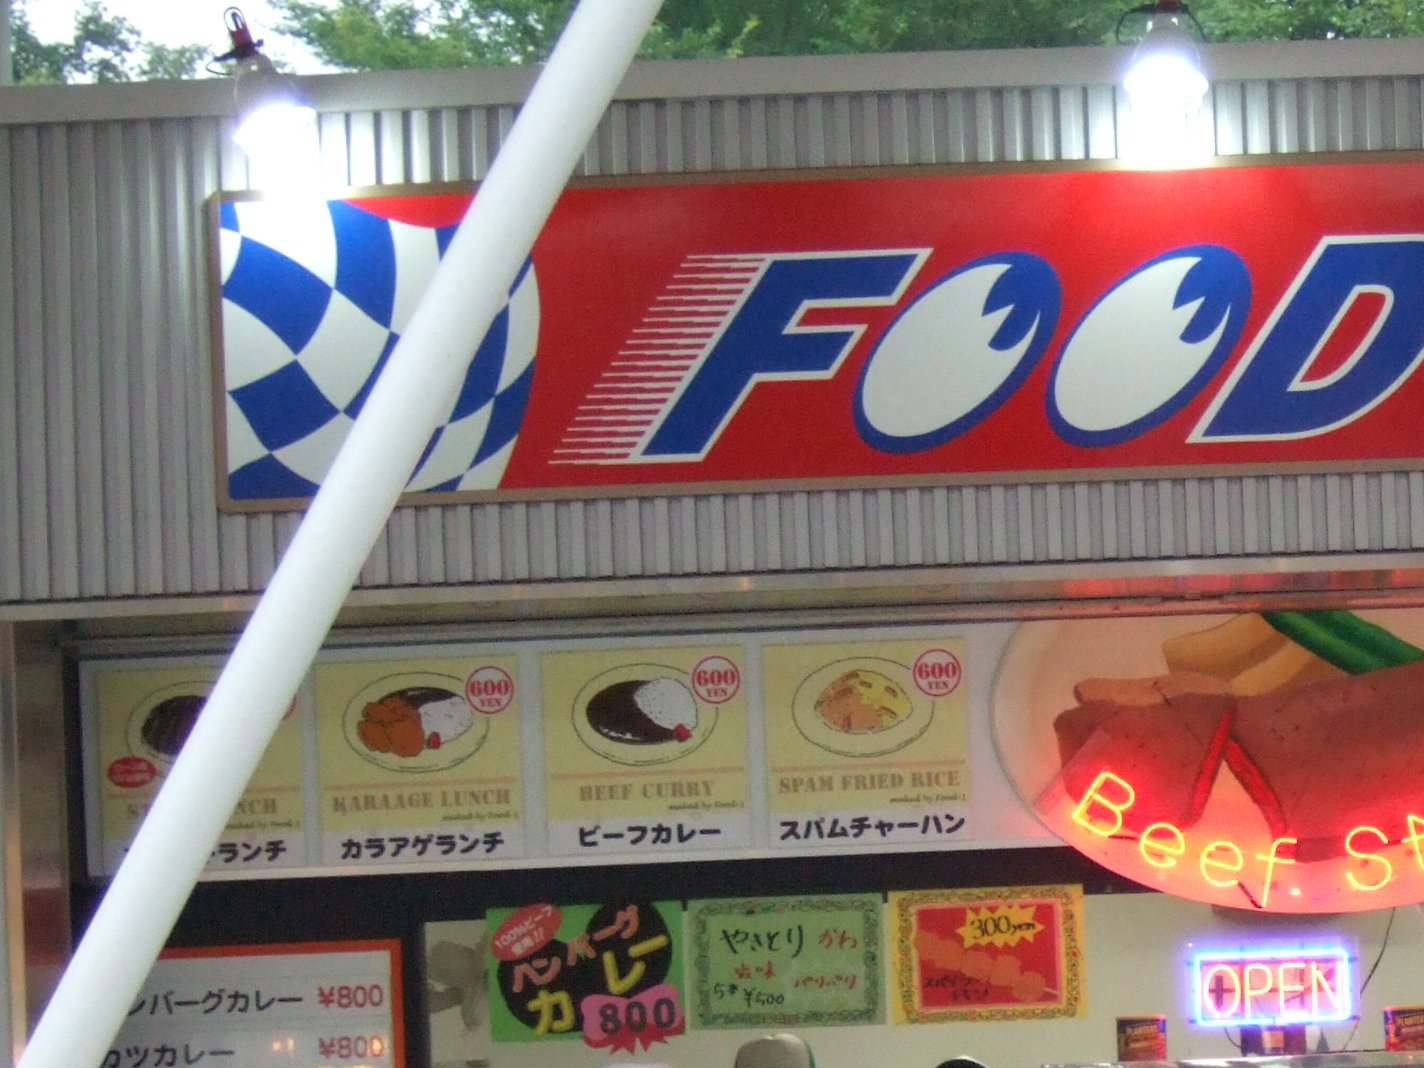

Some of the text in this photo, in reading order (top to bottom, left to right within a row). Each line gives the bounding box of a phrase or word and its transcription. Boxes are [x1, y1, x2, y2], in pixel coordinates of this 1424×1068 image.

[696, 669, 736, 687] 600
[917, 662, 957, 680] 600
[469, 679, 510, 698] 600
[579, 780, 714, 802] BEEF CURRY
[777, 770, 960, 795] SPAM FRIED RICE
[332, 788, 511, 813] KARAAGE LUNCH
[578, 823, 722, 848] ビーフカレー
[779, 813, 966, 841] スパムチャーハン
[1071, 770, 1298, 908] Beef
[341, 830, 505, 860] カラアゲランチ
[317, 982, 385, 1009] ¥800
[1202, 961, 1344, 1019] OPEN
[598, 996, 676, 1036] 800
[318, 1035, 386, 1061] ¥800
